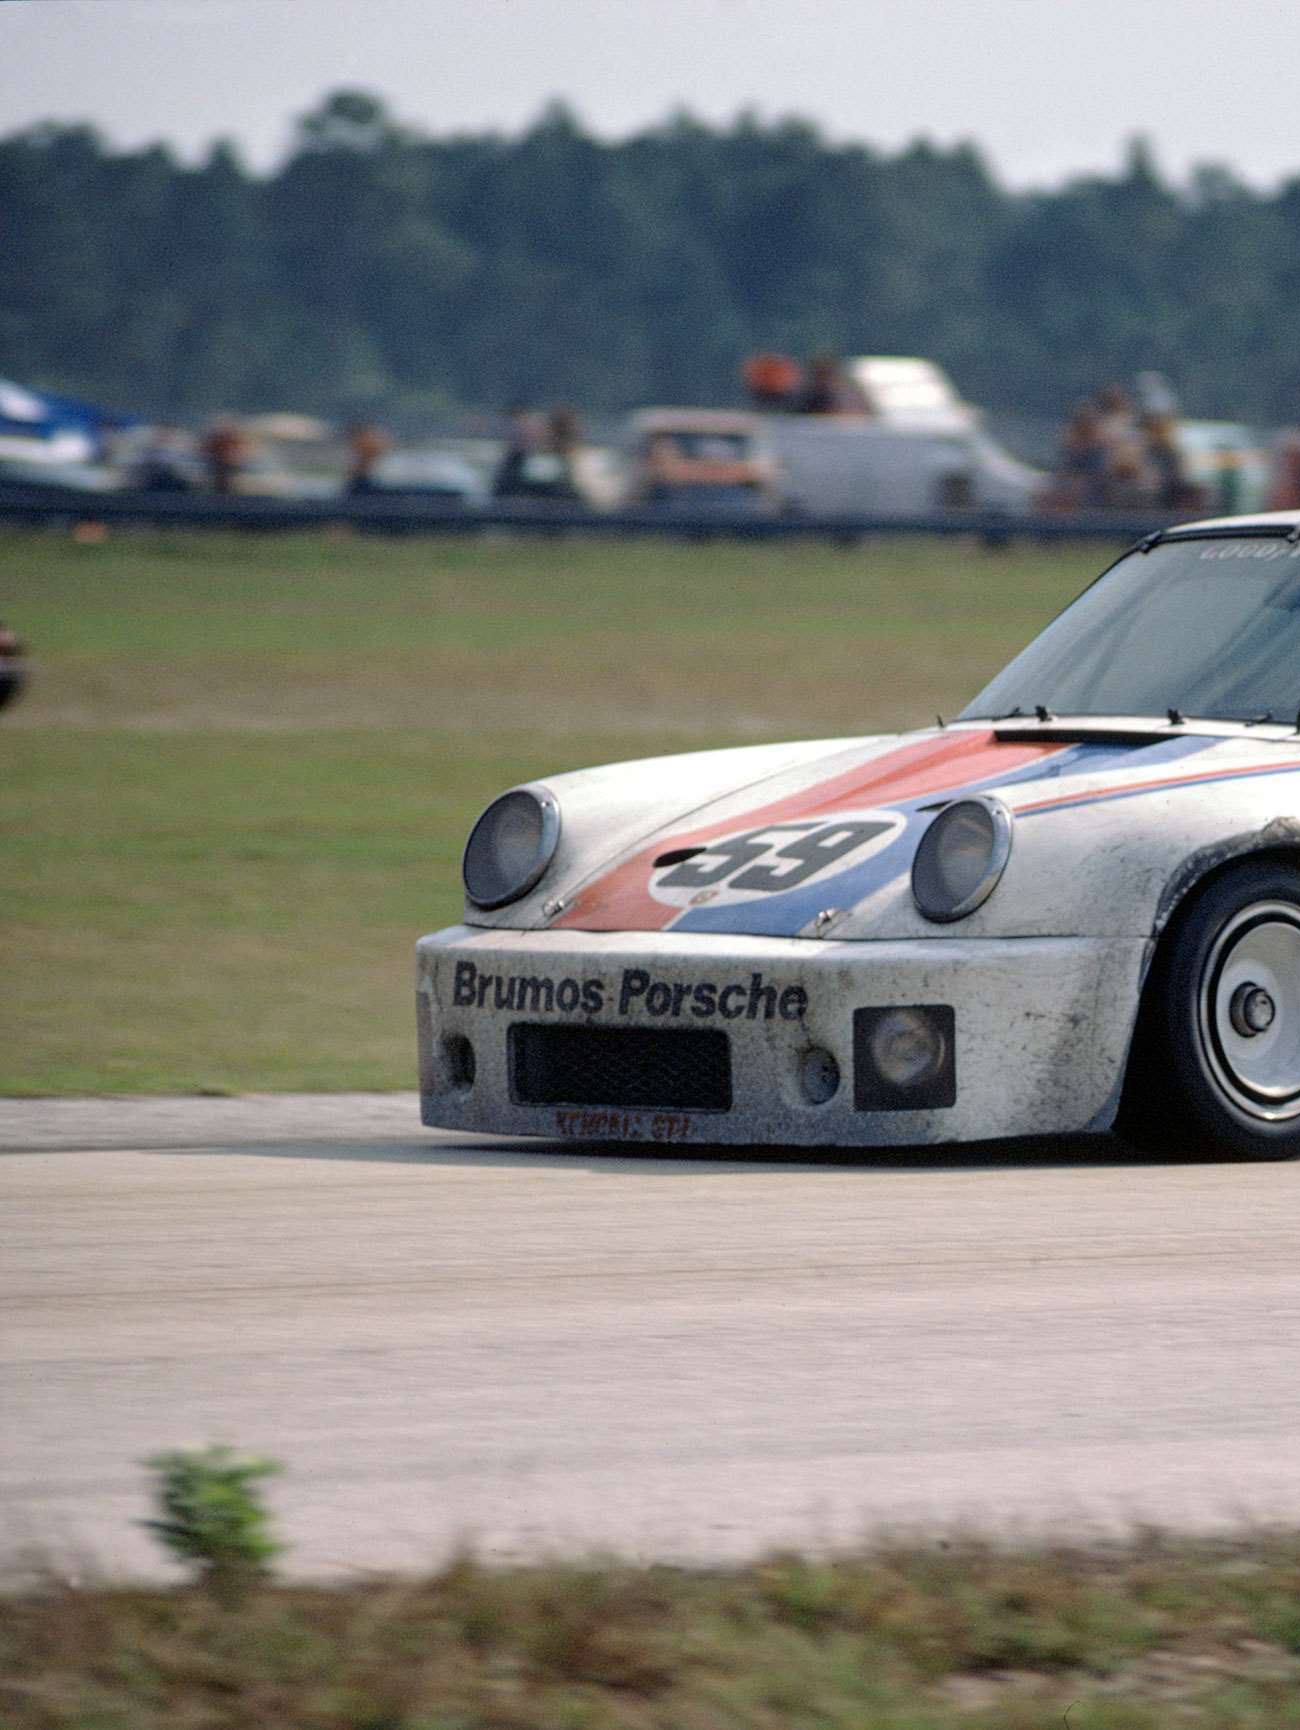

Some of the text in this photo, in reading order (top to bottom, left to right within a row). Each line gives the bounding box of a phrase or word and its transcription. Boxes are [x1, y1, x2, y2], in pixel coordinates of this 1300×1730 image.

[655, 821, 897, 893] 59
[452, 960, 809, 1021] Brumos Porsche
